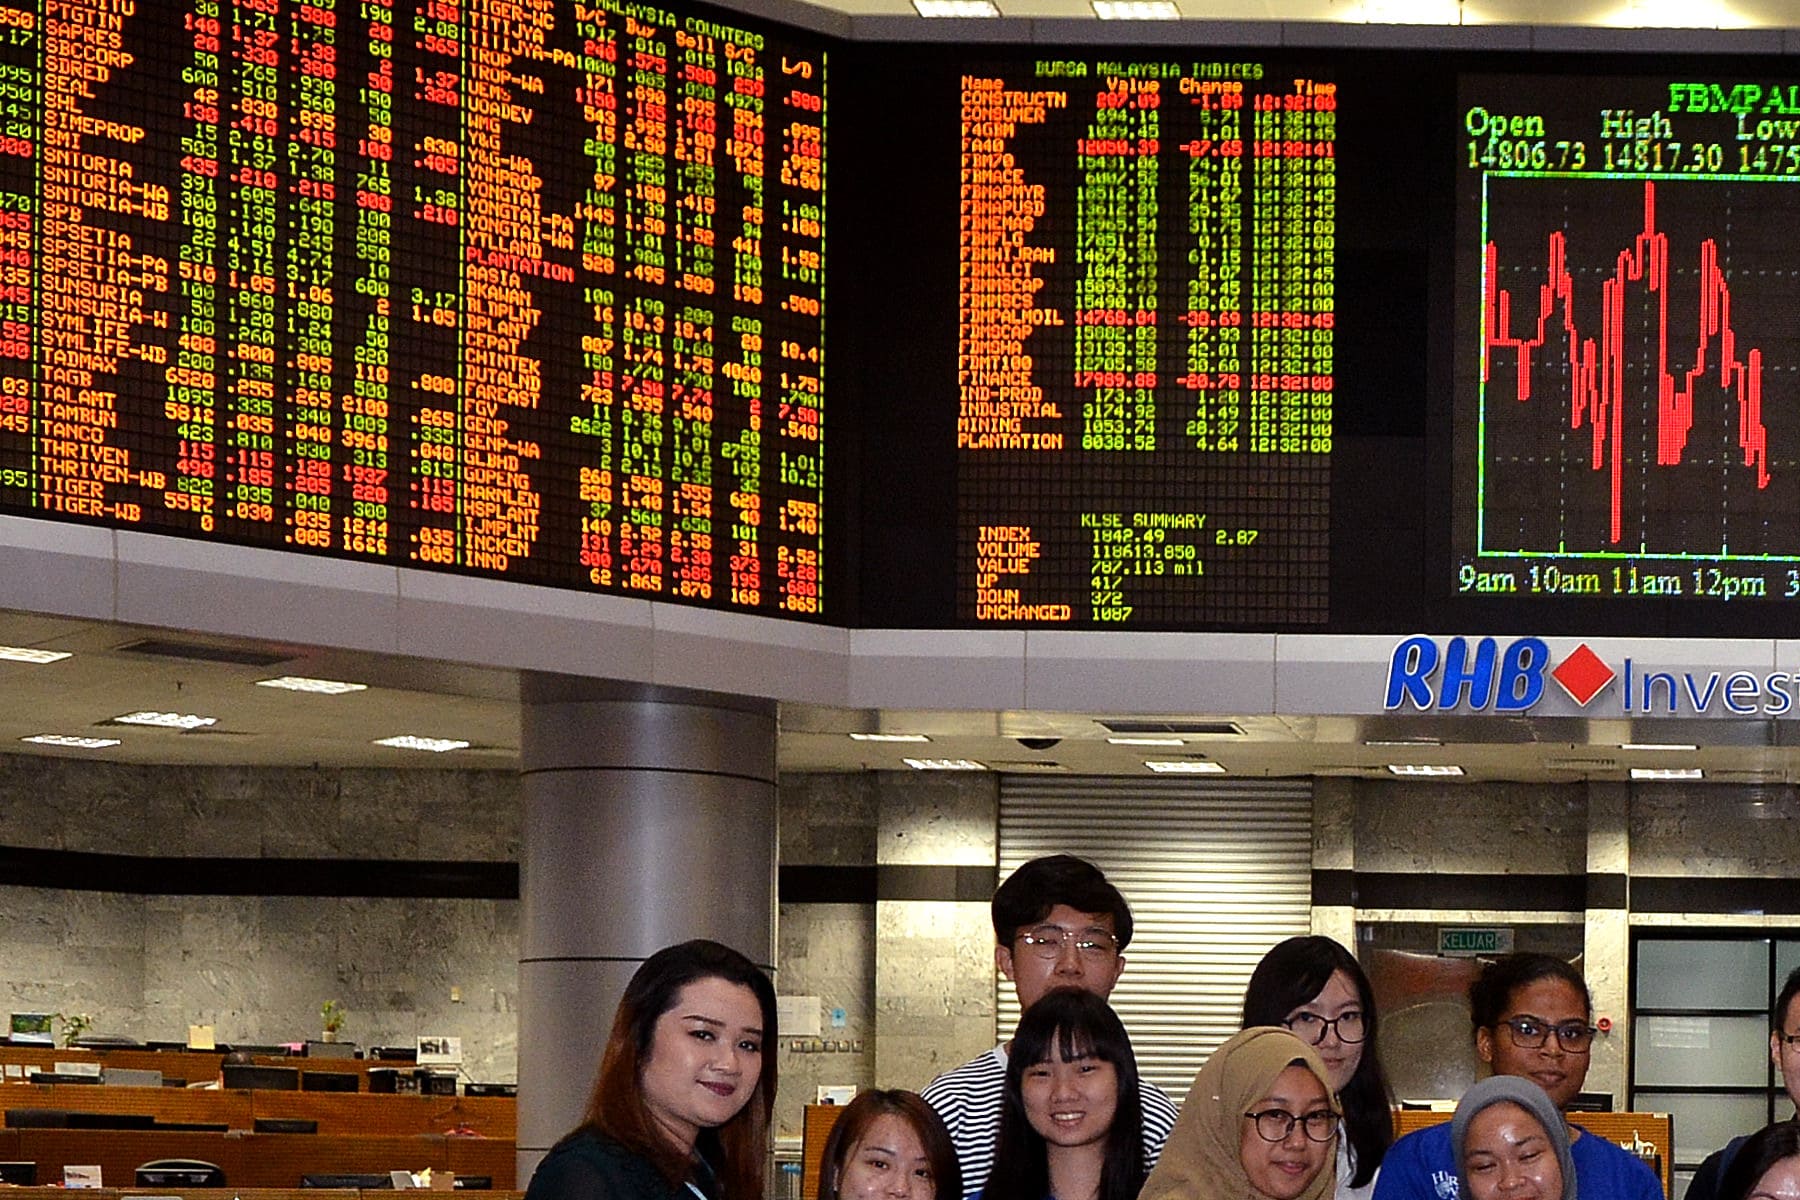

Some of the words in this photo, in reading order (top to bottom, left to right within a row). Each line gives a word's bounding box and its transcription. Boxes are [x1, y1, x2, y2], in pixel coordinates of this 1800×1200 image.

[45, 1, 122, 30] PTGTIN
[470, 12, 544, 44] TITIJYA
[45, 19, 122, 48] SAPRES
[686, 17, 764, 50] COUNTERS
[45, 37, 134, 68] SBCCORP
[470, 46, 512, 66] TROP
[45, 56, 109, 82] SDRED
[1035, 61, 1087, 76] BURSA
[1096, 62, 1181, 77] MALAYSIA
[1193, 62, 1264, 79] INDICES
[45, 74, 96, 98] SEAL
[961, 76, 1004, 91] Name
[1107, 77, 1159, 93] Value
[1180, 78, 1242, 93] Change
[1294, 80, 1336, 95] Time
[45, 92, 82, 113] SHL
[961, 91, 1066, 108] CONSTRUCTN
[45, 110, 144, 143] SIMEPROP
[961, 108, 1046, 123] CONSUMER
[1465, 107, 1545, 148] Open
[1602, 110, 1673, 148] High
[1737, 113, 1800, 141] Low
[44, 128, 80, 149] SMI
[1180, 141, 1242, 156] -27.65
[1254, 141, 1335, 157] 12:32:41
[44, 147, 132, 178] SNTORIA
[1467, 143, 1587, 171] 14806.73
[1603, 144, 1723, 172] 14817.30
[44, 165, 169, 203] SNTORIA-WA
[468, 163, 542, 192] YNHPROP
[44, 184, 169, 220] SNTORIA-WB
[468, 179, 541, 209] YONGTAI
[43, 220, 131, 250] SPSETIA
[42, 238, 168, 274] SPSETIA-PA
[467, 246, 575, 283] PLANTATION
[467, 264, 520, 288] AASIA
[41, 276, 142, 306] SUNSURIA
[467, 280, 531, 307] BKAWAN
[41, 294, 168, 328] SUNSURIA-W
[41, 311, 130, 340] SYMLIFE
[41, 329, 166, 363] SYMLIFE-WB
[466, 331, 520, 355] CEPAT
[465, 349, 540, 376] CHINTEK
[41, 365, 92, 387] TAGB
[41, 346, 117, 374] TADMAX
[165, 368, 215, 389] 6520
[227, 382, 274, 398] .255
[286, 392, 332, 409] .265
[342, 395, 389, 418] 2100
[411, 408, 455, 429] .265
[959, 372, 1031, 386] FINANCE
[1075, 373, 1157, 387] 17989.88
[1251, 375, 1333, 391] 12:32:00
[41, 384, 116, 410] TALAMT
[464, 381, 540, 410] FAREAST
[464, 399, 498, 416] FGV
[960, 387, 1042, 401] IND-PROD
[1095, 389, 1153, 403] 173.31
[1251, 391, 1332, 406] 12:32:00
[41, 402, 117, 428] TAMBUN
[464, 416, 508, 432] GENP
[959, 403, 1062, 417] INDUSTRIAL
[1083, 404, 1156, 419] 3174.92
[1197, 405, 1239, 420] 4.49
[1251, 407, 1332, 422] 12:32:00
[41, 420, 104, 443] TANCO
[958, 418, 1020, 432] MINING
[1186, 421, 1238, 436] 28.37
[1250, 422, 1332, 437] 12:32:00
[41, 438, 129, 465] THRIVEN
[464, 433, 541, 459] GENP-WA
[957, 434, 1063, 449] PLANTATION
[1082, 435, 1156, 450] 8038.52
[1197, 437, 1239, 451] 4.64
[1249, 438, 1331, 453] 12:32:00
[41, 476, 104, 498] TIGER
[41, 493, 140, 521] TIGER-WB
[464, 502, 539, 525] HSPLANT
[1081, 514, 1123, 527] KLSE
[1133, 513, 1206, 529] SUMMARY
[466, 534, 529, 557] INCKEN
[979, 526, 1030, 542] INDEX
[1093, 530, 1165, 542] 1842.49
[1216, 530, 1258, 545] 2.87
[977, 542, 1040, 558] VOLUME
[1093, 545, 1196, 559] 118613.850
[977, 558, 1030, 574] VALUE
[1091, 561, 1164, 575] 787.113
[1175, 561, 1204, 575] mil
[465, 551, 508, 571] INNO
[590, 569, 612, 586] 62
[622, 575, 663, 592] .865
[673, 582, 711, 598] .870
[730, 587, 760, 605] 168
[779, 595, 817, 613] .865
[977, 574, 999, 588] UP
[1091, 576, 1123, 590] 417
[1459, 566, 1516, 592] 9am
[1530, 568, 1600, 594] 10am
[1612, 570, 1682, 594] 11am
[1692, 570, 1766, 600] 12pm
[977, 589, 1019, 604] DOWN
[1091, 592, 1123, 605] 372
[976, 605, 1070, 620] UNCHANGED
[1092, 607, 1132, 621] 1087
[1385, 633, 1550, 712] RHB
[1442, 932, 1495, 949] KELUAR
